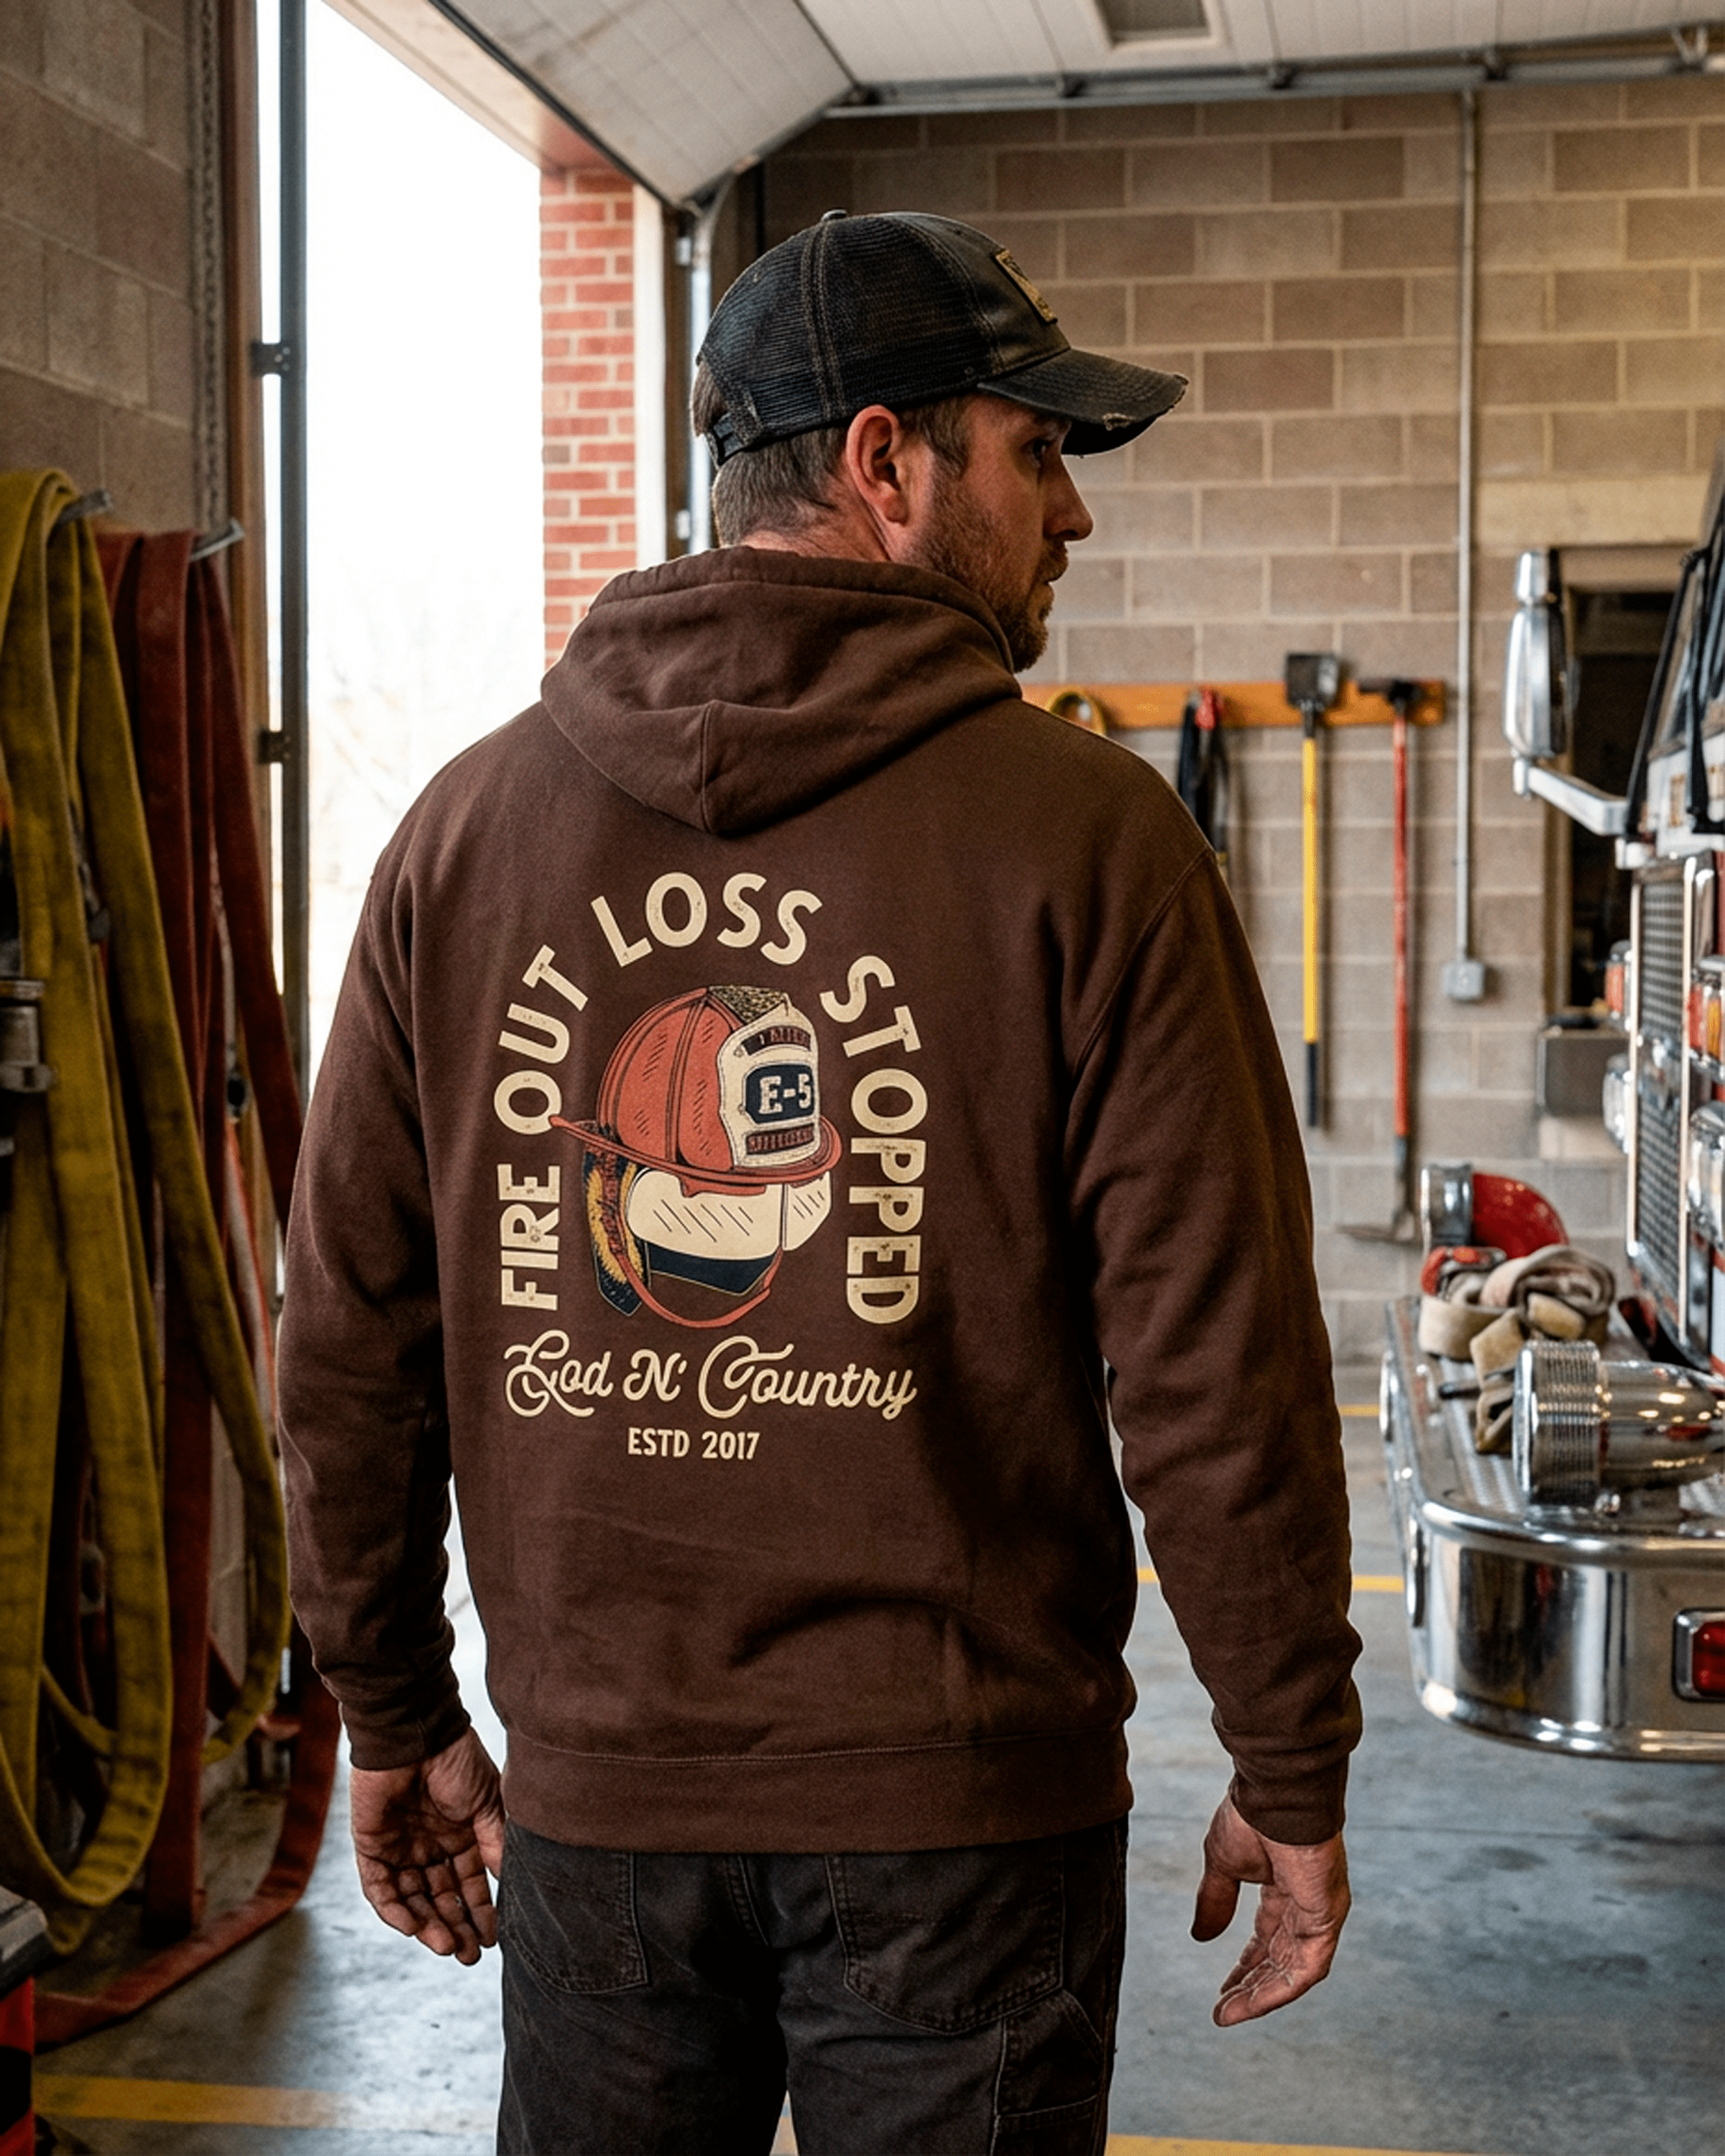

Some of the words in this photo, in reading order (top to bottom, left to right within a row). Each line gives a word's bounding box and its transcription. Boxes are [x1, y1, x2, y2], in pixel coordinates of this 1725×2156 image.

[591, 872, 822, 967] LOSS
[494, 944, 589, 1135] OUT
[758, 1074, 811, 1114] E-5
[819, 956, 927, 1324] STOPPED
[497, 1164, 561, 1310] FIRE
[504, 1330, 613, 1417] God
[698, 1335, 917, 1420] Country
[627, 1427, 690, 1457] ESTD
[702, 1431, 760, 1460] 2017
